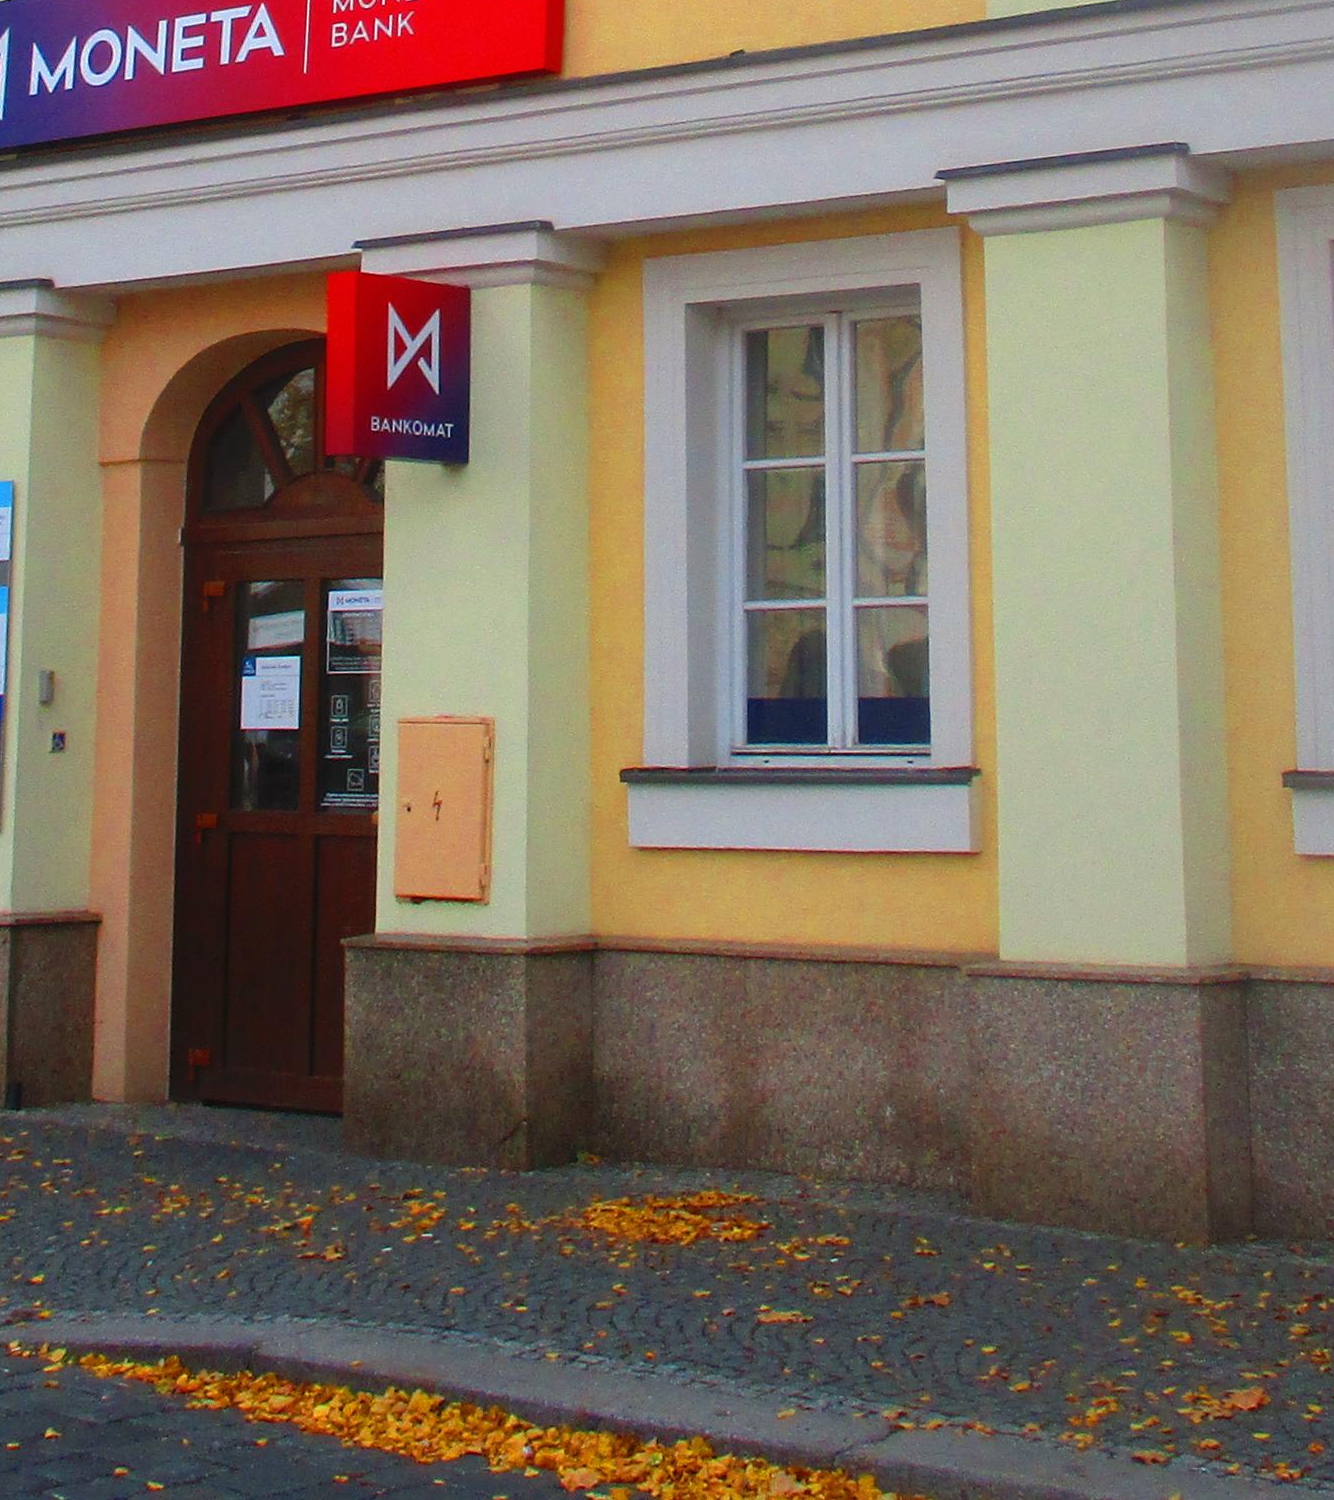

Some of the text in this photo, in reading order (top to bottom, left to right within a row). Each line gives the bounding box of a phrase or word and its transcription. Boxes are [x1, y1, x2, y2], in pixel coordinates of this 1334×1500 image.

[329, 10, 417, 49] BANK
[28, 2, 285, 98] MONETA
[370, 416, 454, 439] BANKOMAT
